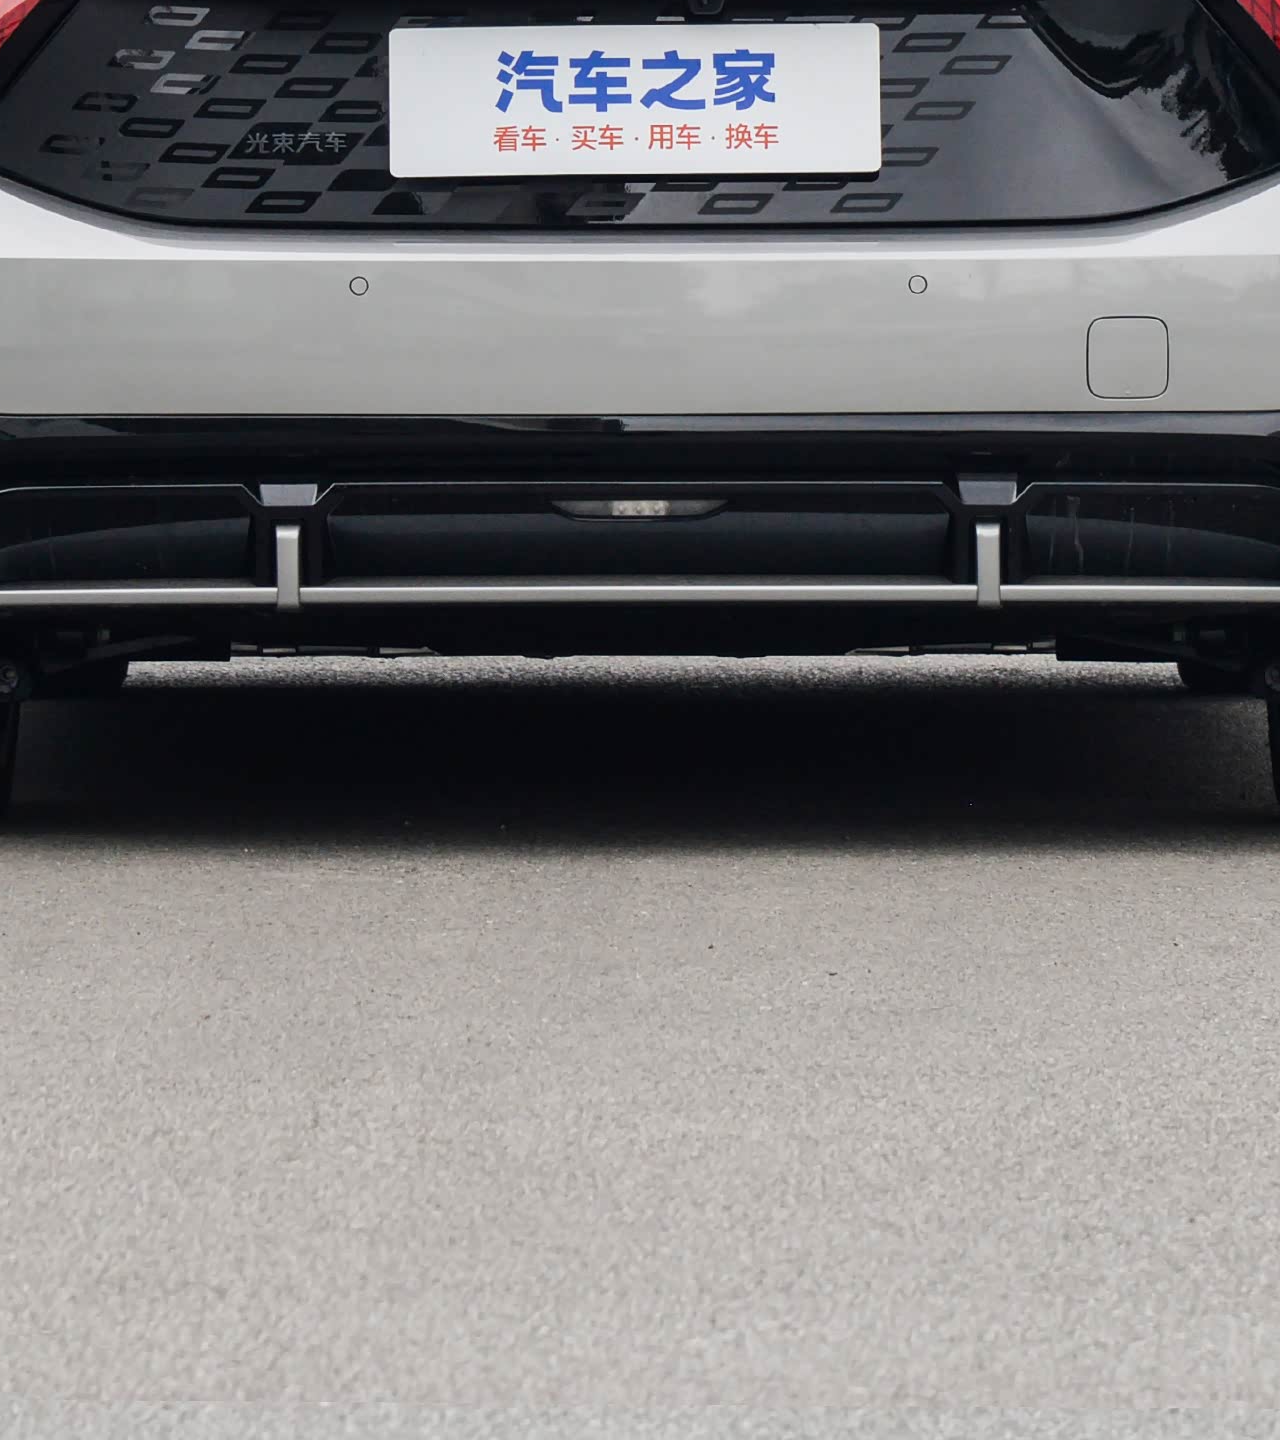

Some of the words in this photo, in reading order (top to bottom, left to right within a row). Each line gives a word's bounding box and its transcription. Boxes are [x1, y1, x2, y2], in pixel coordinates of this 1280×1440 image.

[494, 48, 777, 113] 汽车之家
[244, 131, 348, 154] 光束汽车
